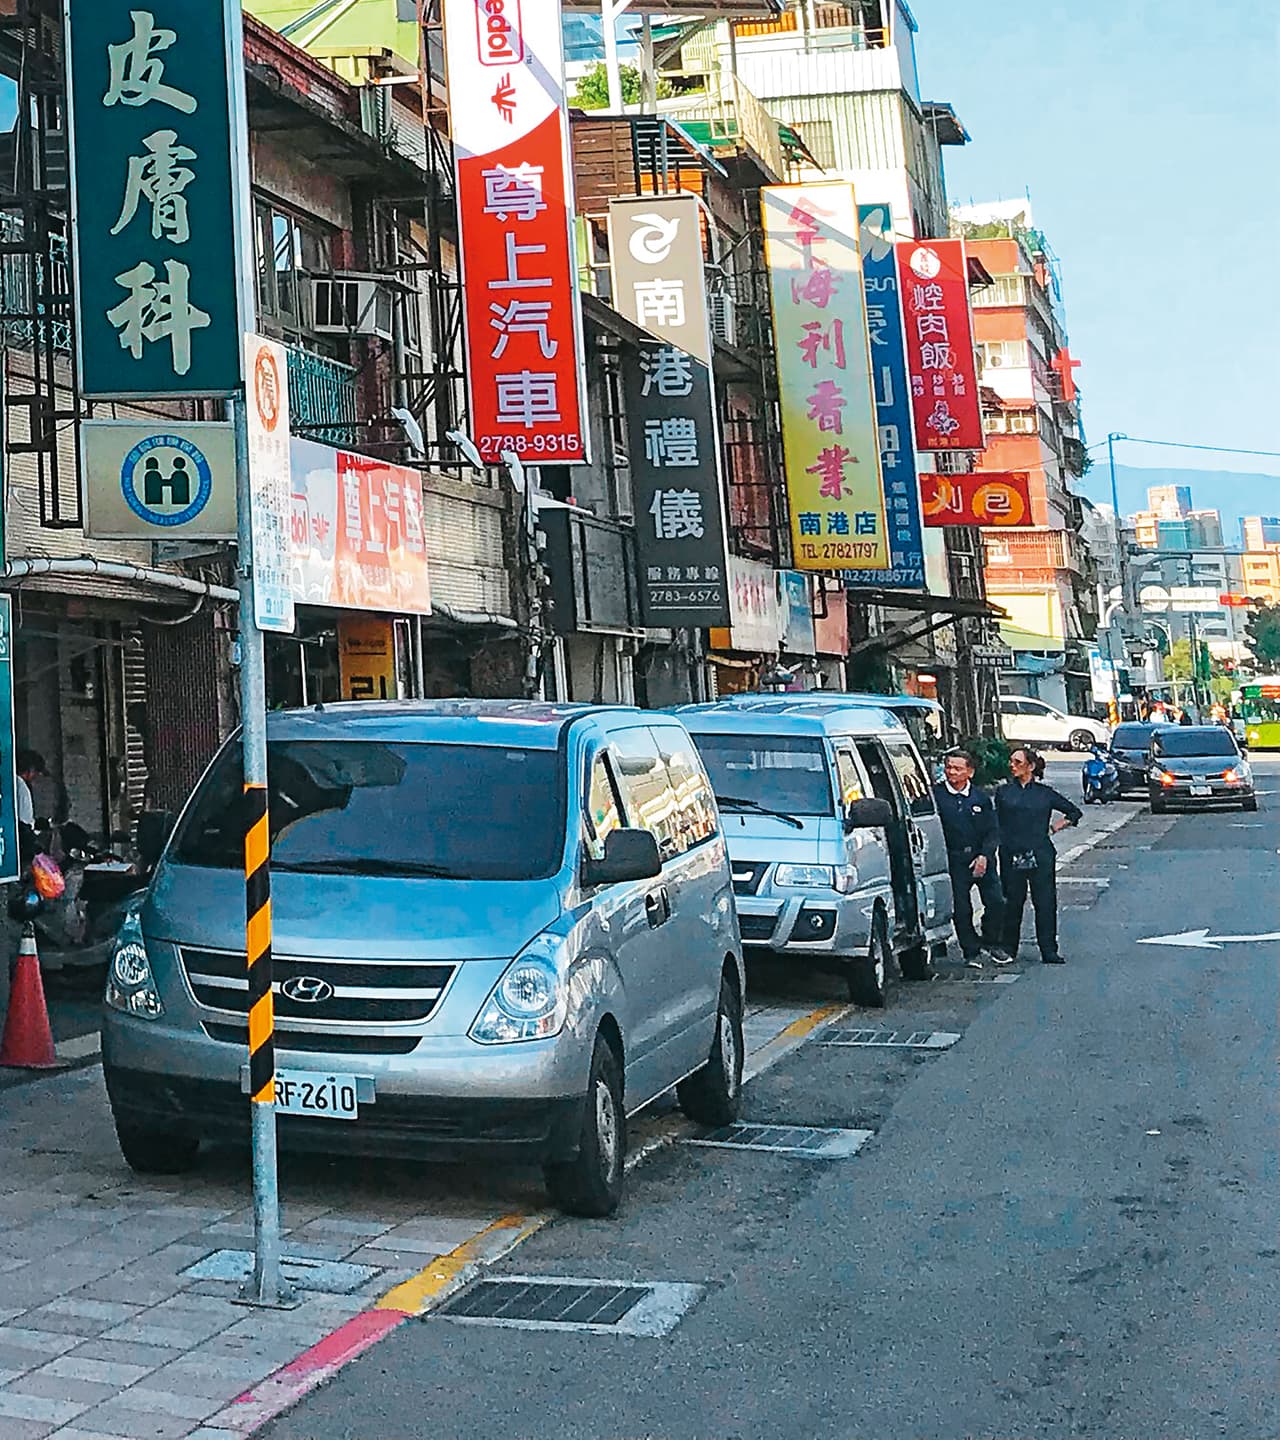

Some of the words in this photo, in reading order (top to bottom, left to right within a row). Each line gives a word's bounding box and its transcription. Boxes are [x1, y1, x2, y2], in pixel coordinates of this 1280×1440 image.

[481, 161, 561, 428] 尊上汽車
[913, 282, 953, 370] 焢肉飯
[632, 278, 704, 540] 南港禮儀
[479, 433, 580, 454] 2788-9315
[342, 466, 425, 561] 尊上汽車
[930, 484, 1013, 514] 刈包
[797, 511, 878, 537] 南港店
[822, 542, 879, 560] 27821797
[649, 589, 721, 603] 2783-6576
[273, 1080, 355, 1112] RF-2610
